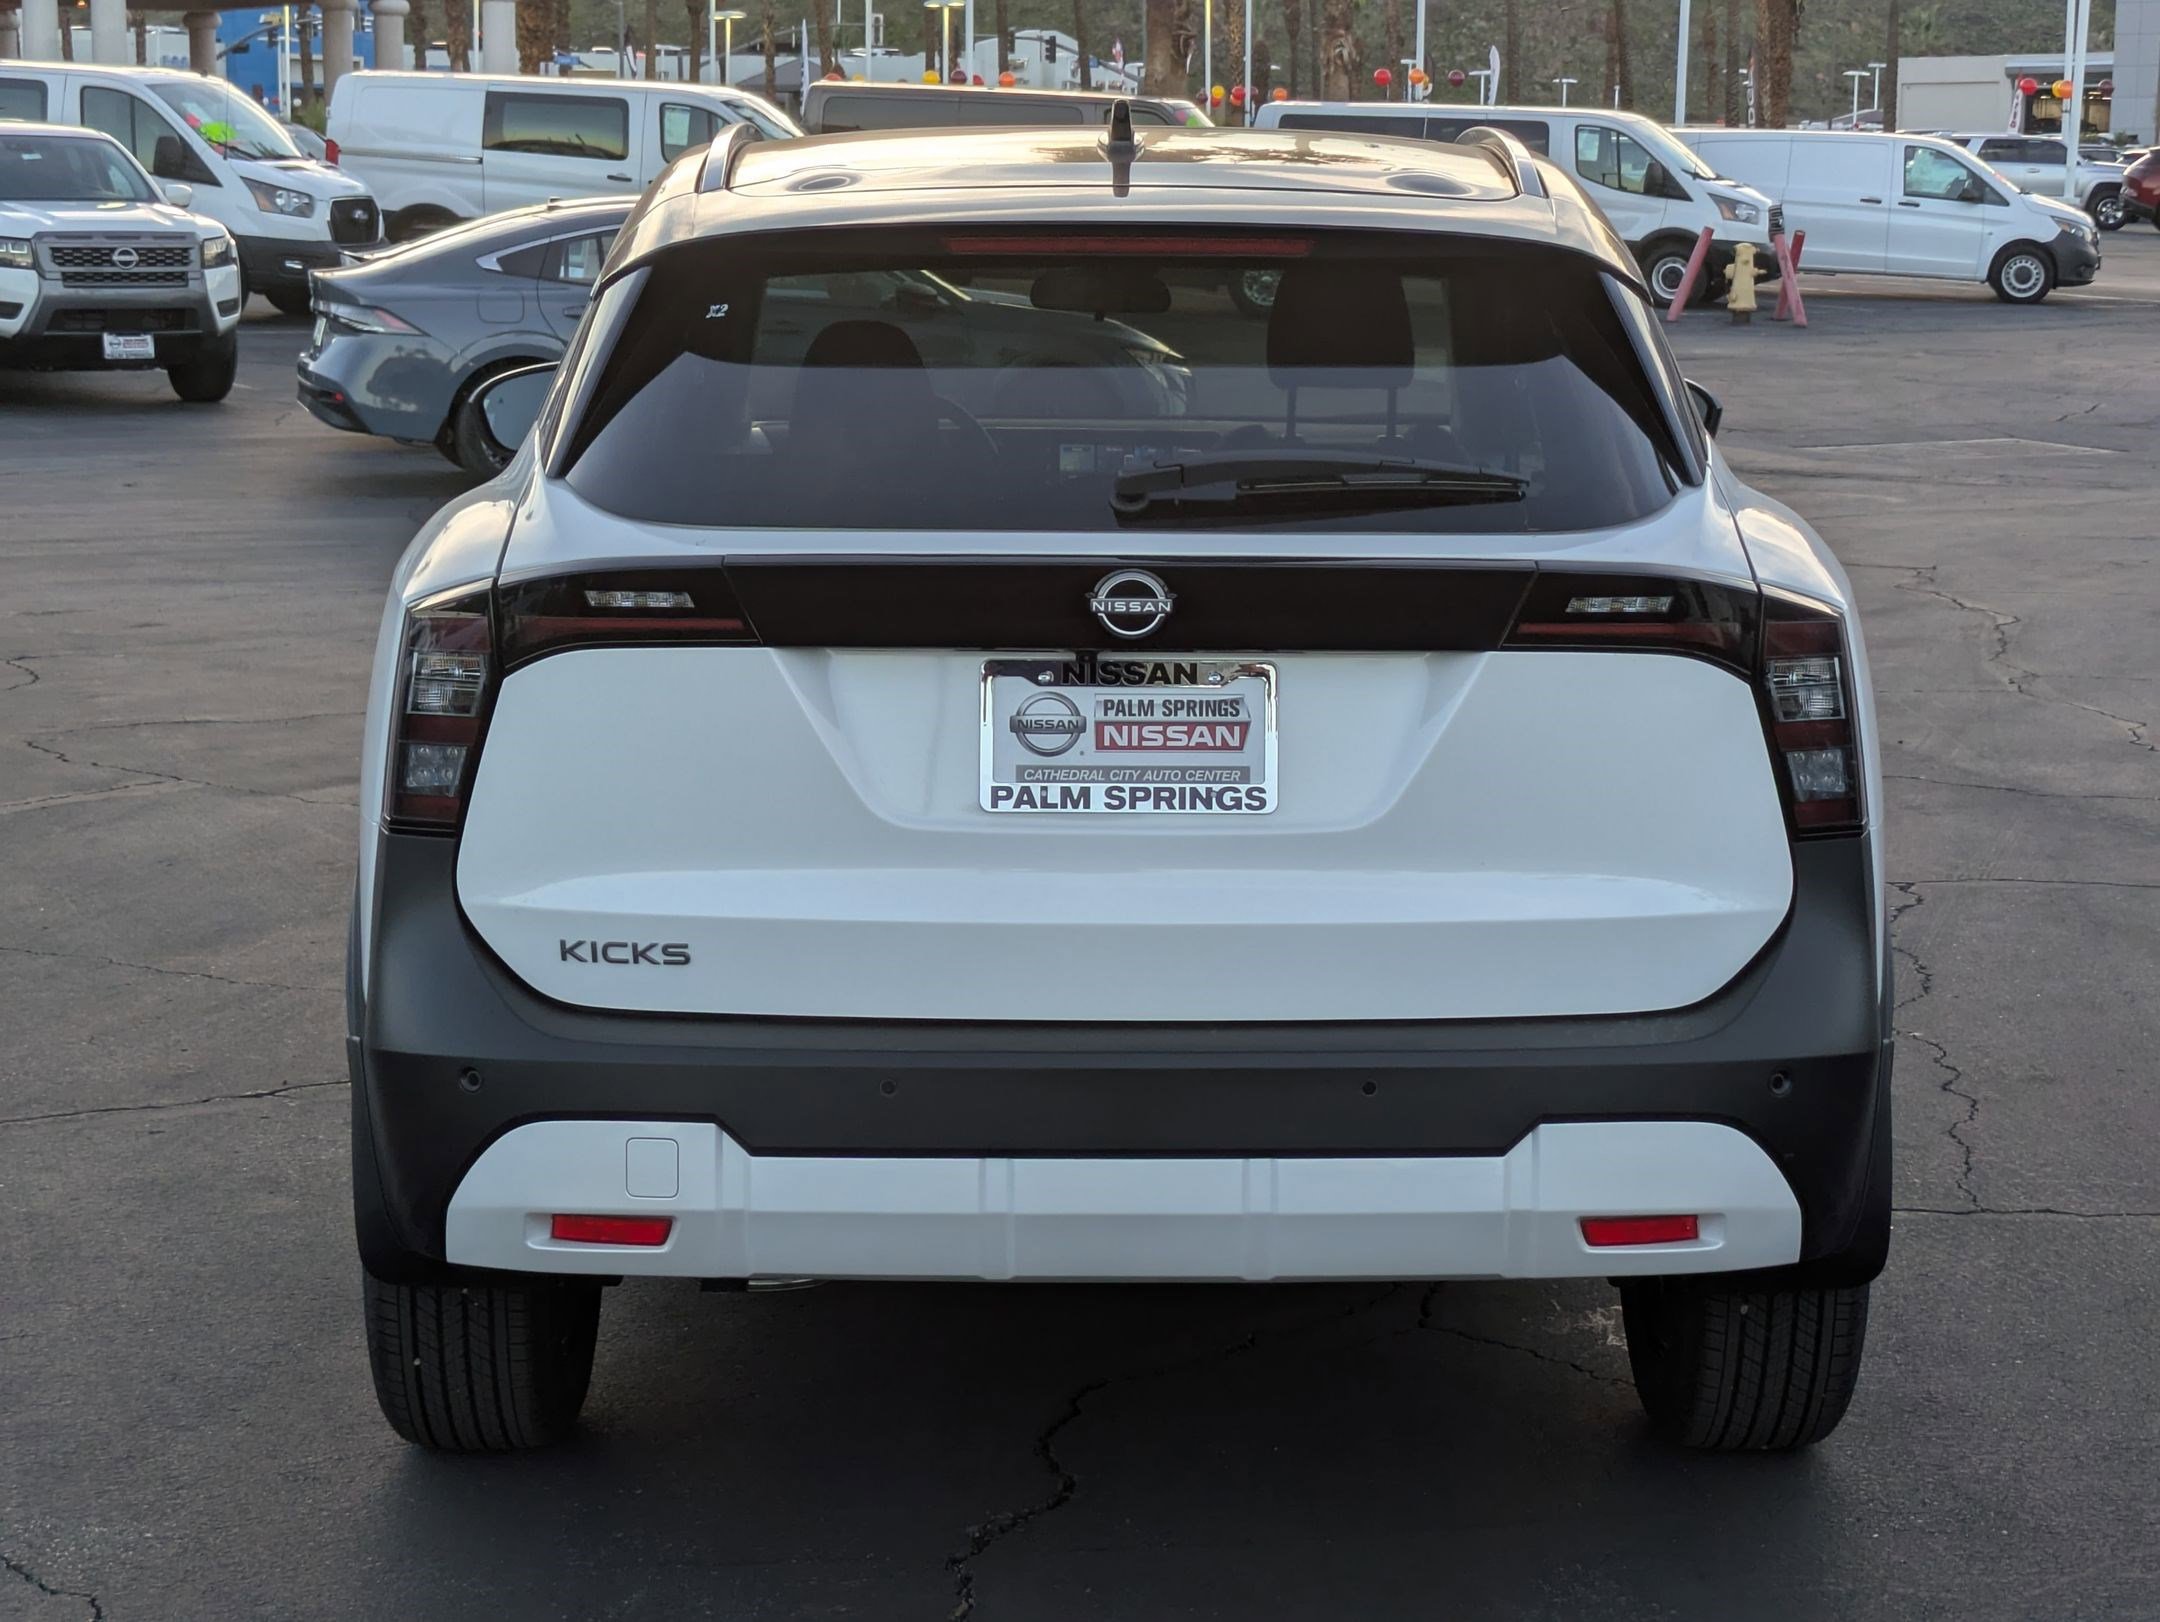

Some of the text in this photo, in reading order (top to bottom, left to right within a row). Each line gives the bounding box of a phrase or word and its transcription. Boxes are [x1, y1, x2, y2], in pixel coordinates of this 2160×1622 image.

[1092, 601, 1171, 612] NISSAN
[1061, 662, 1199, 686] NISSAN
[1103, 699, 1241, 718] PALM SPRINGS
[1017, 719, 1079, 730] NISSAN
[1103, 725, 1241, 747] NISSAN
[1024, 769, 1241, 782] CATHEDRAL CITY AUTO CENTER
[990, 785, 1268, 811] PALM SPRINGS
[559, 939, 692, 966] KICKS
